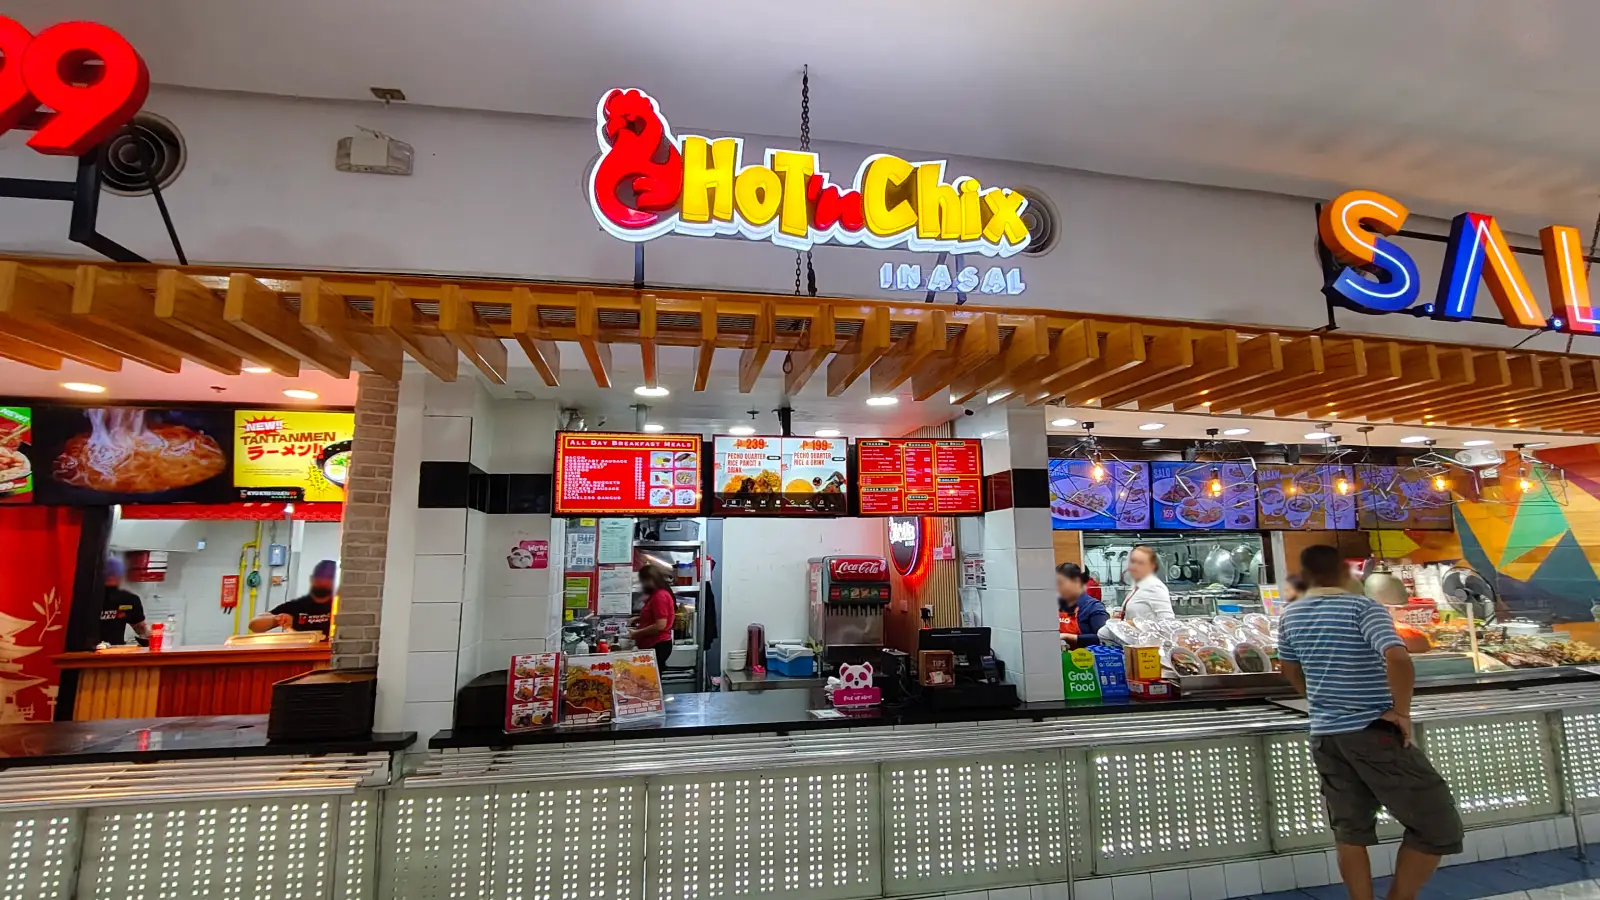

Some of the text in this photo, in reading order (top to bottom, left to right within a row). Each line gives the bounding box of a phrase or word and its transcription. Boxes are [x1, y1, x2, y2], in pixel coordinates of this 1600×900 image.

[861, 154, 1031, 246] Chix
[240, 431, 336, 446] TANTANMEN
[746, 439, 766, 450] 239
[811, 440, 828, 451] 199
[1068, 670, 1094, 681] Grab
[1070, 680, 1096, 692] Food
